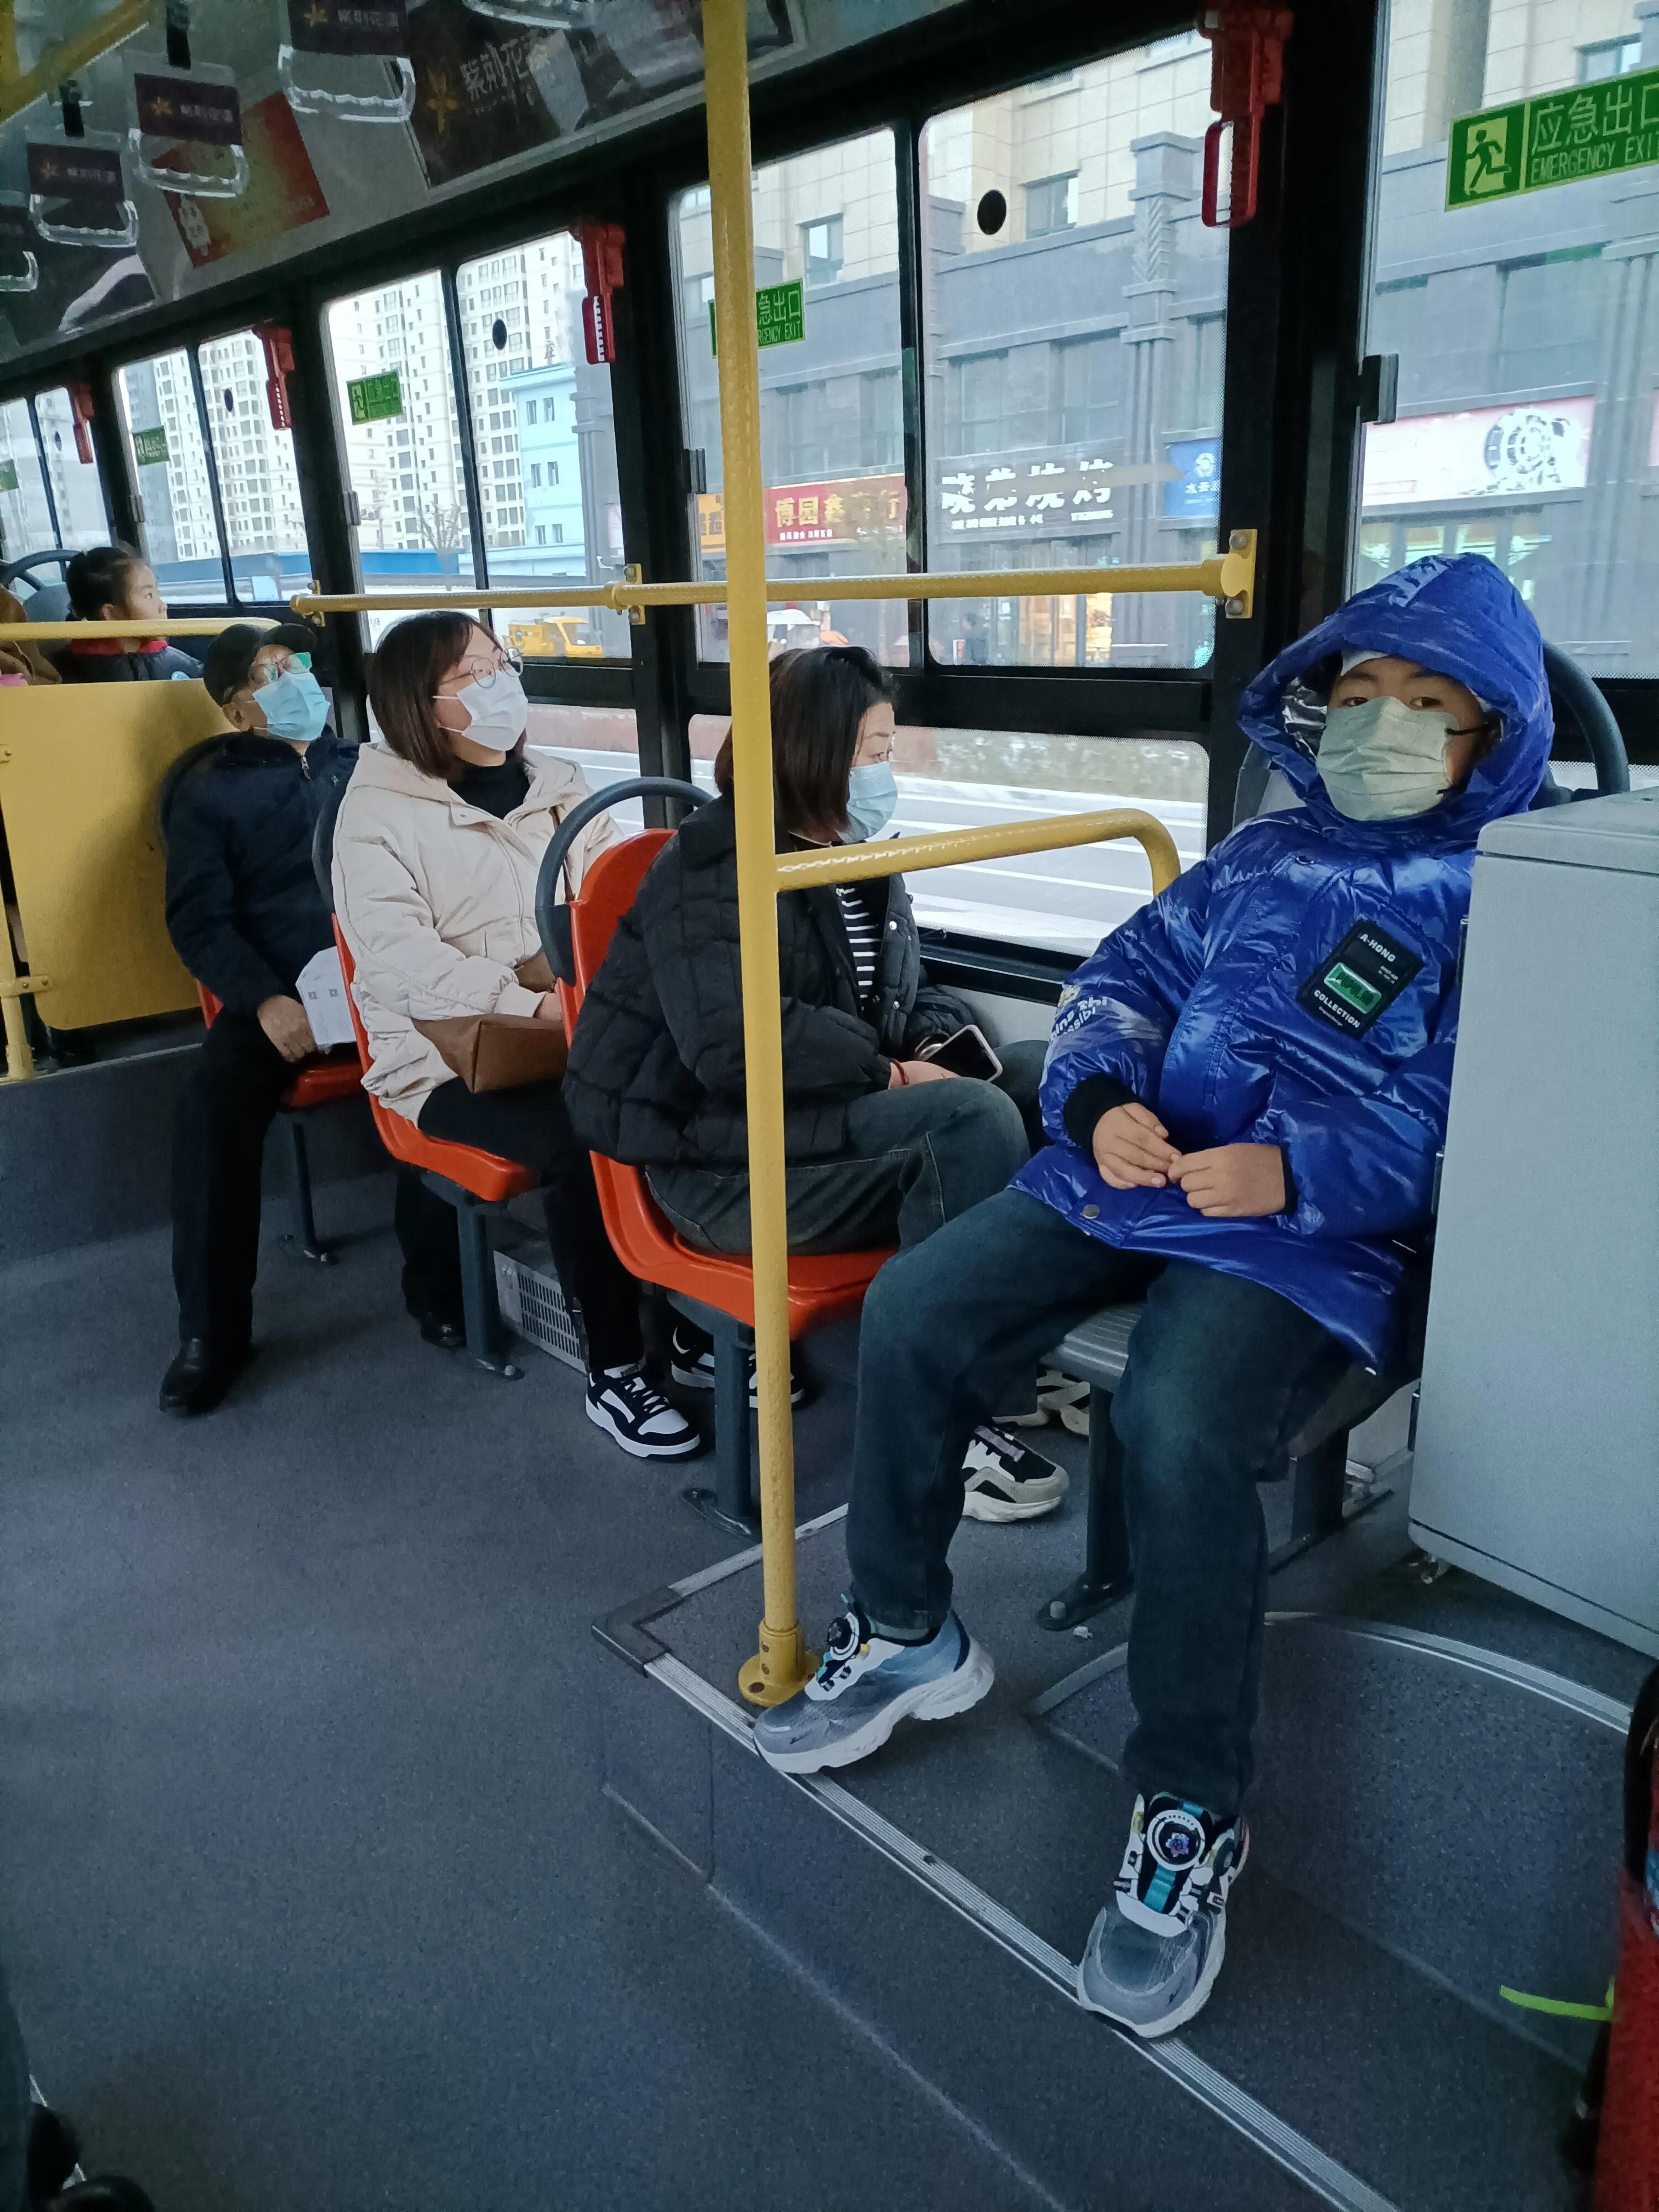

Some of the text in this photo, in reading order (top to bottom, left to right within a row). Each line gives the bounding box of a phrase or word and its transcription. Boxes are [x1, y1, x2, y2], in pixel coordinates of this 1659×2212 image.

[1531, 82, 1659, 155] 应急出口
[1531, 140, 1616, 184] EMERGENCY
[758, 290, 801, 326] 急出口
[757, 325, 781, 345] RGENCY
[1359, 933, 1396, 962] A-HONG
[1314, 989, 1361, 1029] COLLECTION
